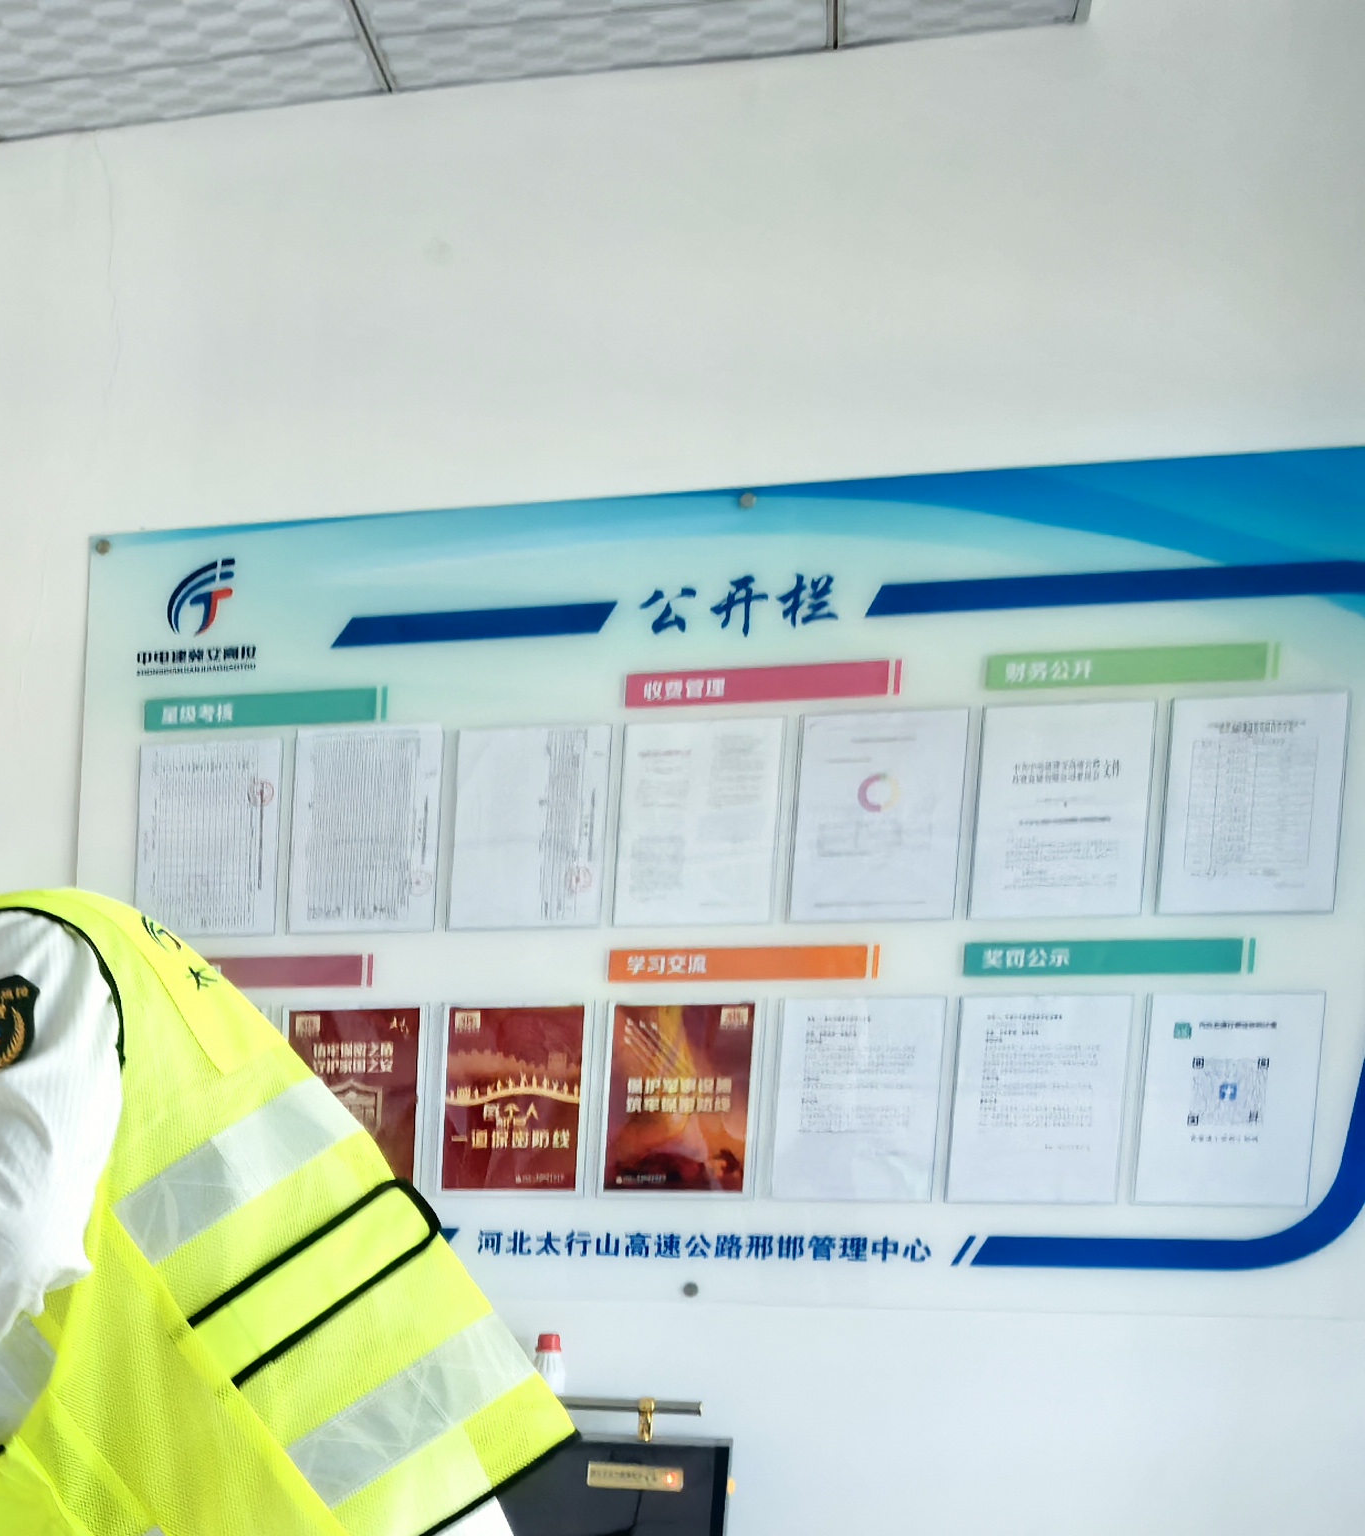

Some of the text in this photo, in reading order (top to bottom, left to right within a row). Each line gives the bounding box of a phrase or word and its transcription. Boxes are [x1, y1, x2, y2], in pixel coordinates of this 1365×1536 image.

[639, 573, 838, 637] 公开栏
[1005, 660, 1092, 683] 财务公开
[644, 678, 725, 701] 收费管理
[627, 954, 707, 976] 学习交流
[982, 948, 1070, 968] 奖罚公示
[478, 1229, 932, 1262] 河北太行山高速公路邢邯管理中心
